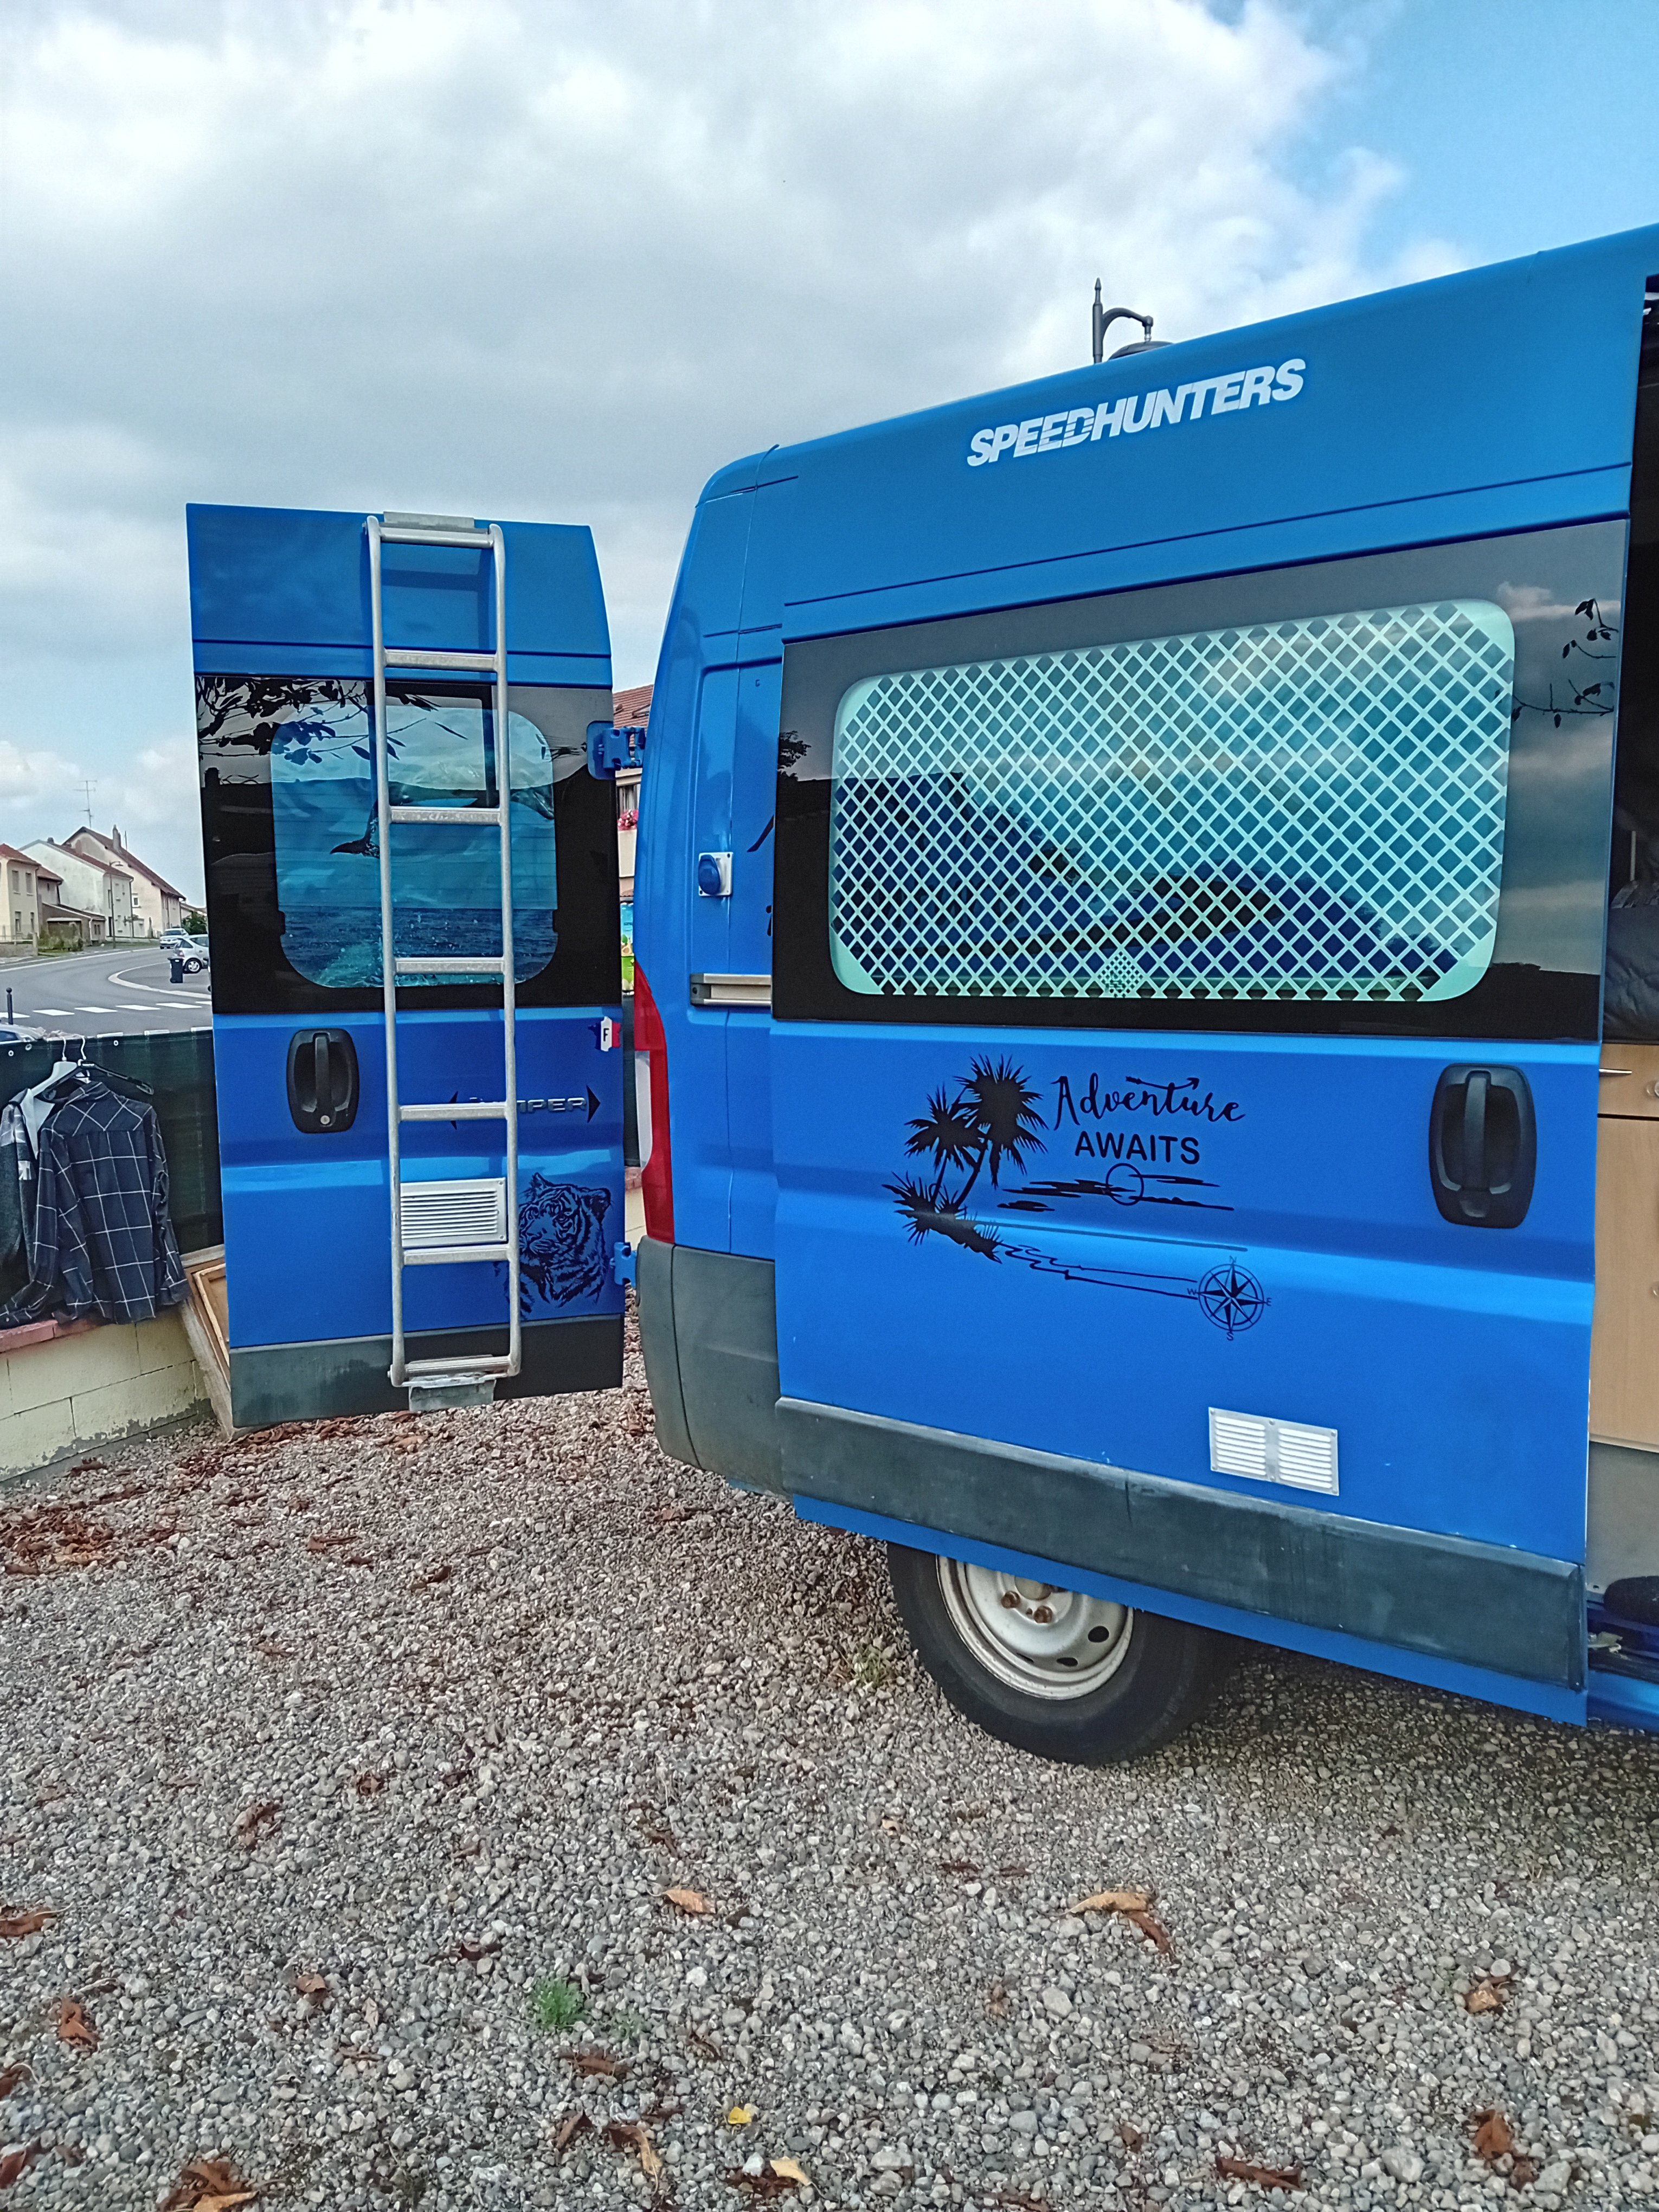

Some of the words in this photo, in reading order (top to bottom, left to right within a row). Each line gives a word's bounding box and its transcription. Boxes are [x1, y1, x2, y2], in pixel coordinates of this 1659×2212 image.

[967, 358, 1306, 467] SPEEDHUNTERS
[603, 1027, 610, 1042] F
[1051, 1072, 1246, 1131] Adventure
[1074, 1130, 1200, 1165] AWAITS
[1229, 1255, 1237, 1263] N
[1266, 1297, 1272, 1307] E
[1226, 1331, 1234, 1341] S
